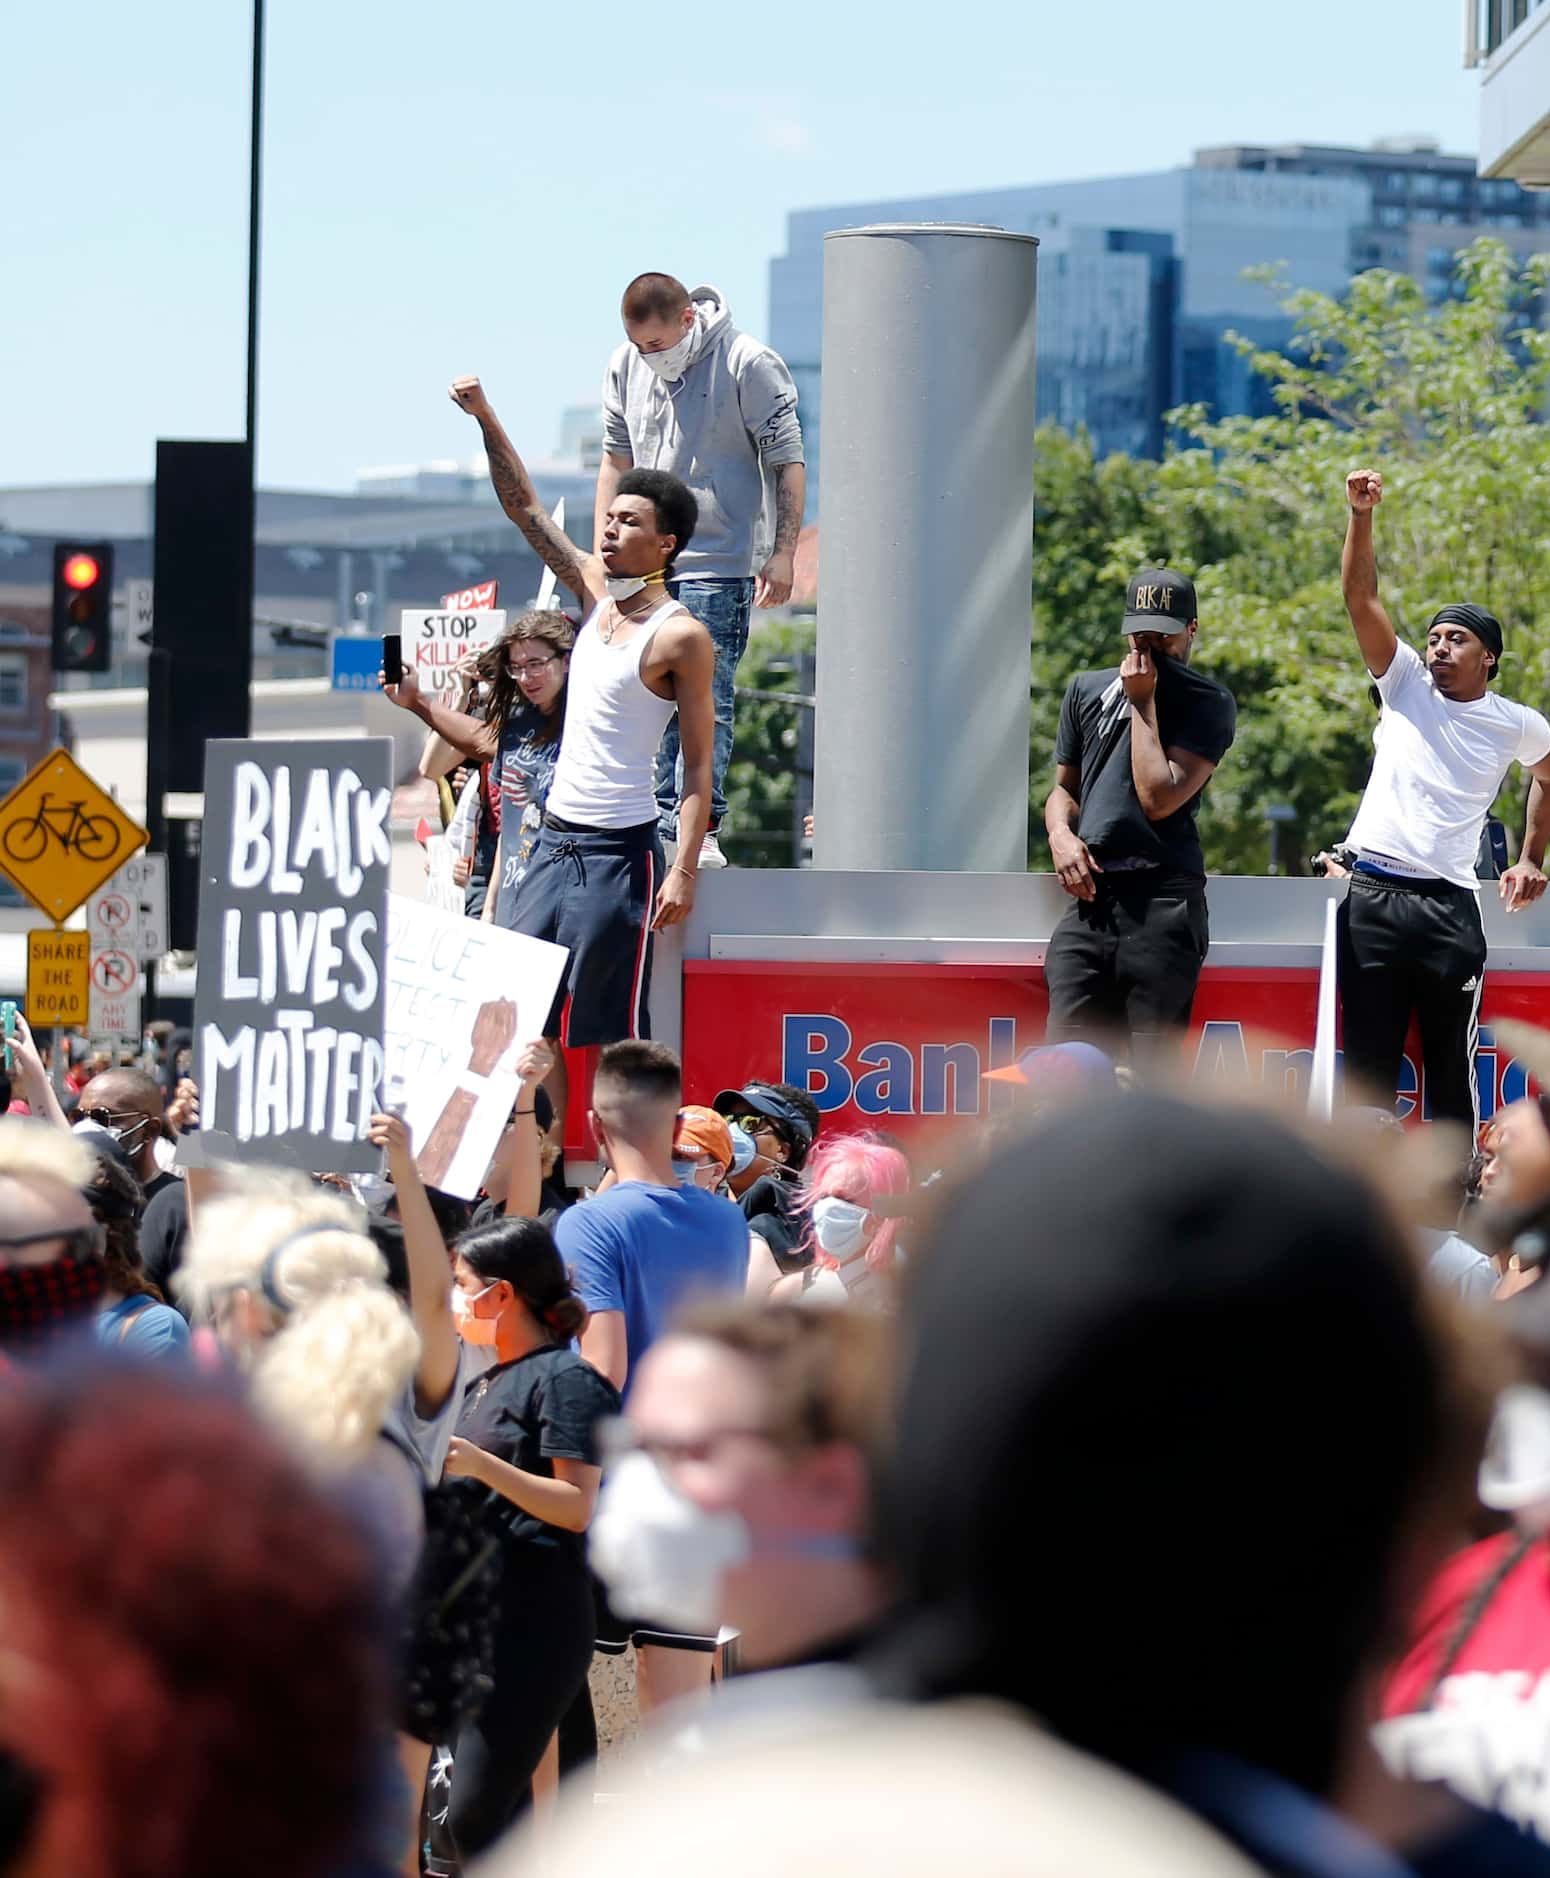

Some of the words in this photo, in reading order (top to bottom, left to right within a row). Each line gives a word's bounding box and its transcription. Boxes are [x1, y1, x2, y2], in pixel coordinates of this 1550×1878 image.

[1136, 585, 1158, 609] BLK
[1160, 586, 1173, 609] AF
[421, 616, 477, 638] STOP
[415, 641, 490, 668] KILLI
[229, 761, 392, 897] BLACK
[33, 943, 85, 960] SHARE
[222, 907, 379, 1012] LIVES
[43, 969, 73, 985] THE
[36, 994, 79, 1011] ROAD
[102, 1003, 127, 1016] ANY
[102, 1016, 127, 1030] TIME
[201, 1008, 386, 1142] MATTER
